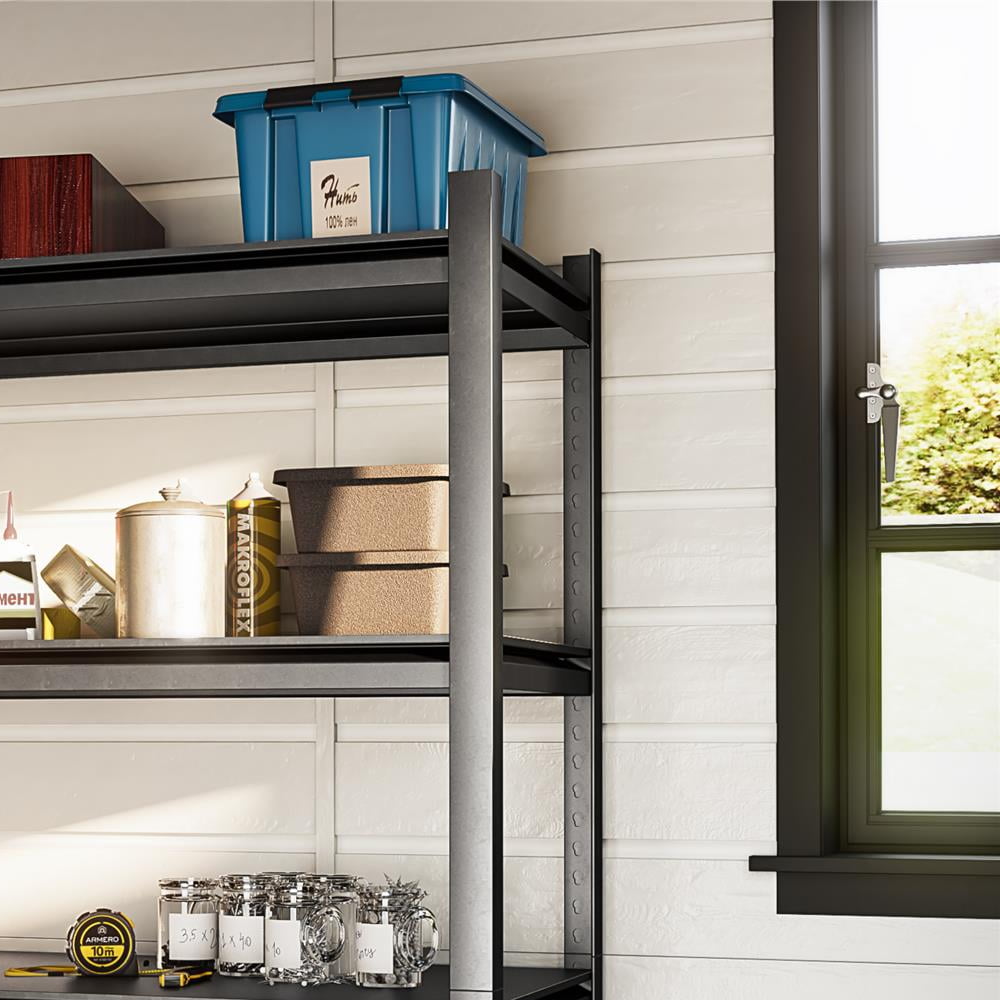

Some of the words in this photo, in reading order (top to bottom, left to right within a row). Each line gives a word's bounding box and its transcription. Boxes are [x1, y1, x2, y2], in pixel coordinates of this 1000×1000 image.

[325, 215, 343, 229] 100%
[236, 513, 251, 633] MAKROFLEX
[85, 936, 119, 944] ARMERO
